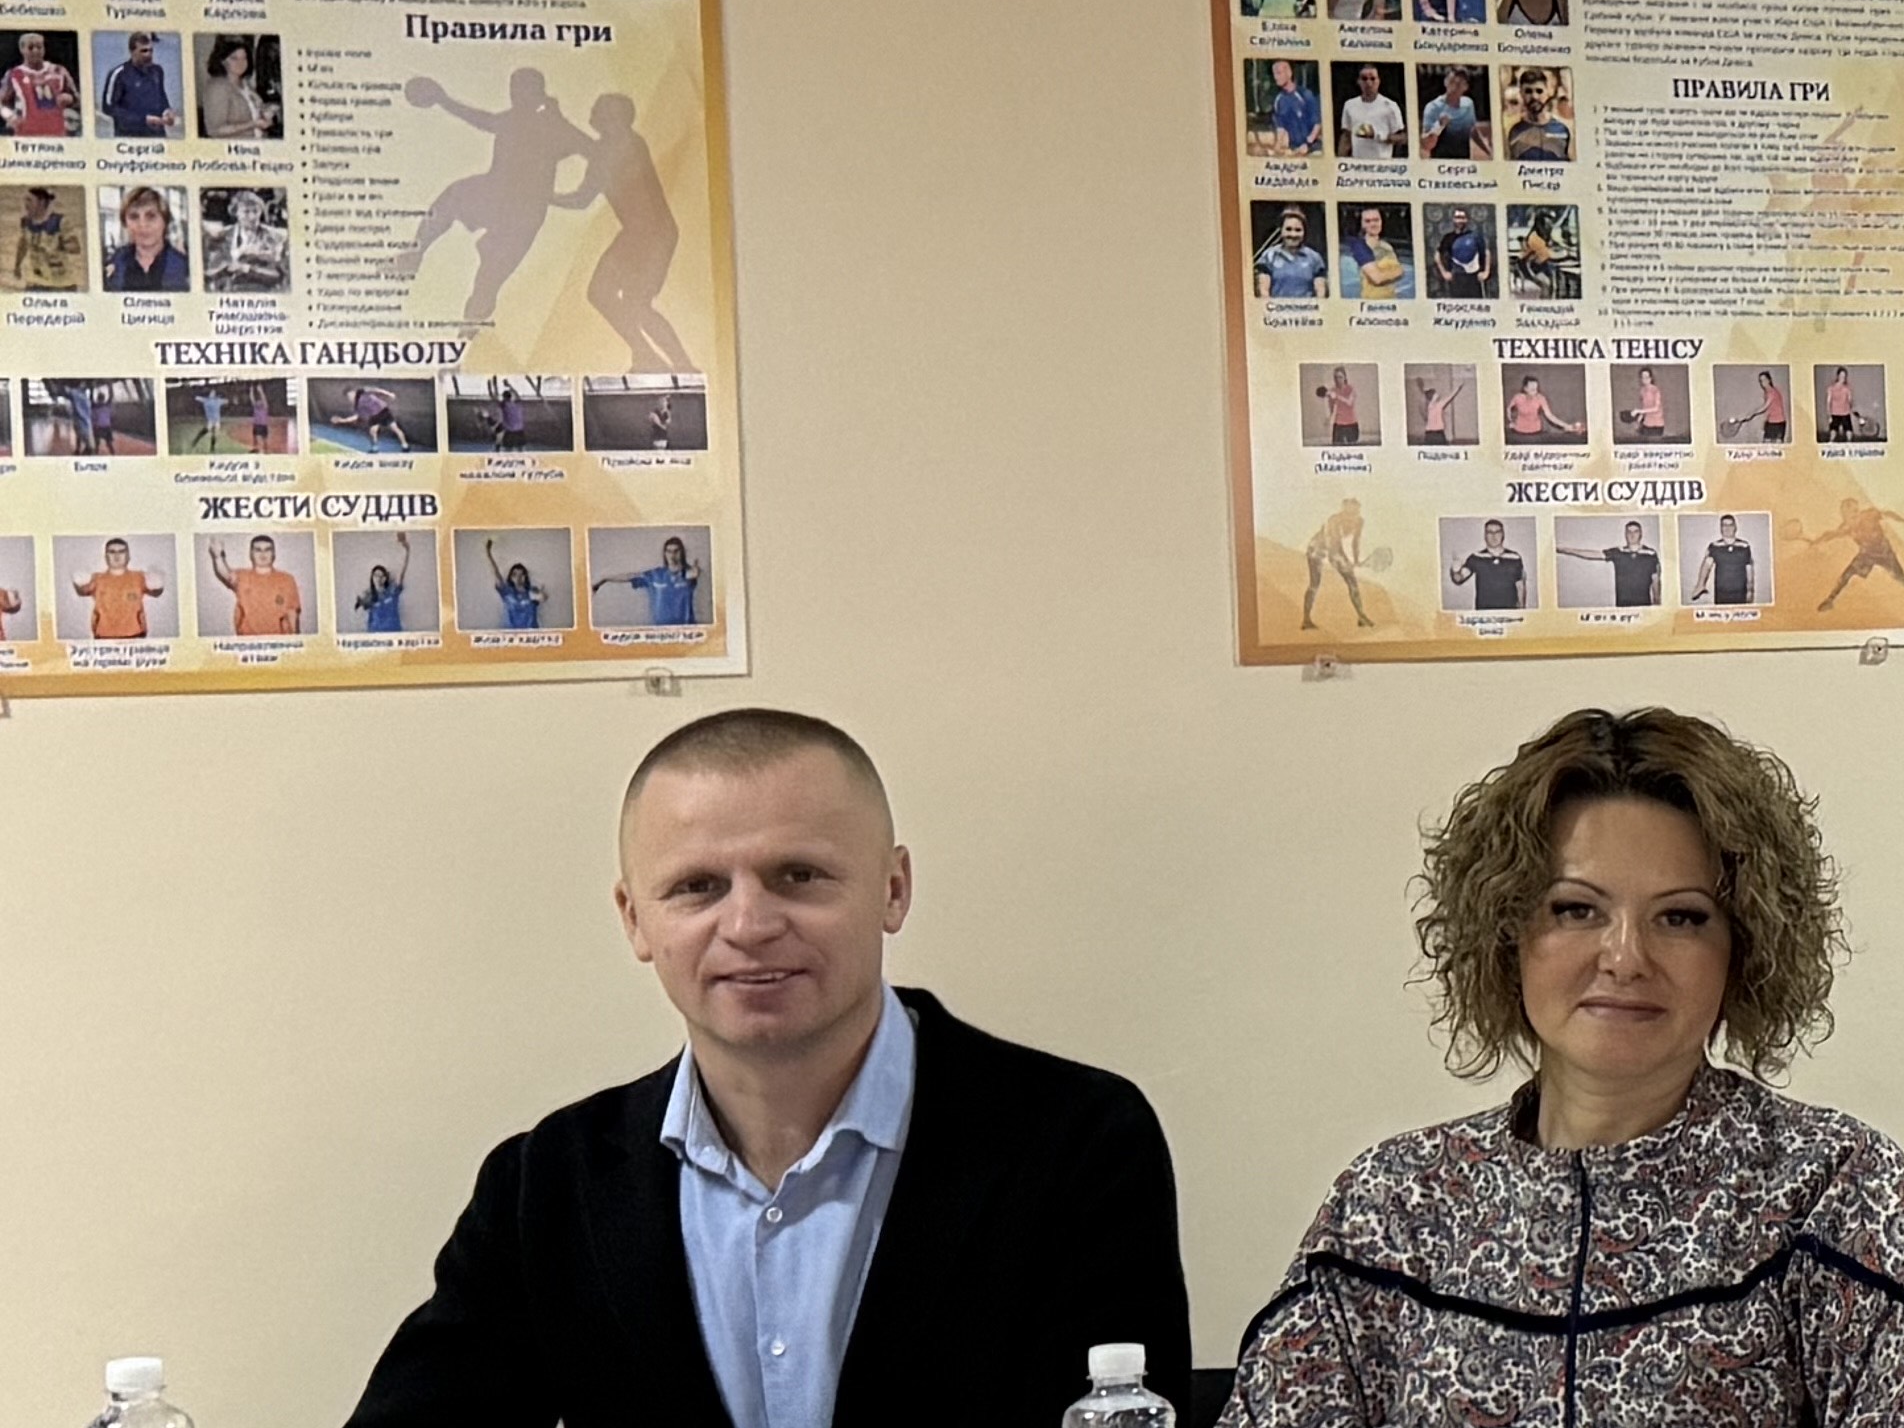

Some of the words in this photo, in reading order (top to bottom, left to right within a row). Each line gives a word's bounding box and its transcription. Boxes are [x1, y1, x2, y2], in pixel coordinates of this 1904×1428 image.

[404, 13, 546, 45] Правила
[556, 22, 613, 47] гри
[1672, 78, 1784, 101] ПРАВИЛА
[1789, 81, 1830, 102] ГРИ
[155, 340, 289, 366] ТЕХНІКА
[299, 340, 468, 370] ГАНДБОЛУ
[1493, 338, 1606, 360] ТЕХНІКА
[1612, 337, 1705, 360] ТЕНІСУ
[1507, 482, 1599, 504] ЖЕСТИ
[1606, 480, 1705, 507] СУДДІВ
[200, 495, 312, 520] ЖЕСТИ
[320, 493, 439, 523] СУДДІВ
